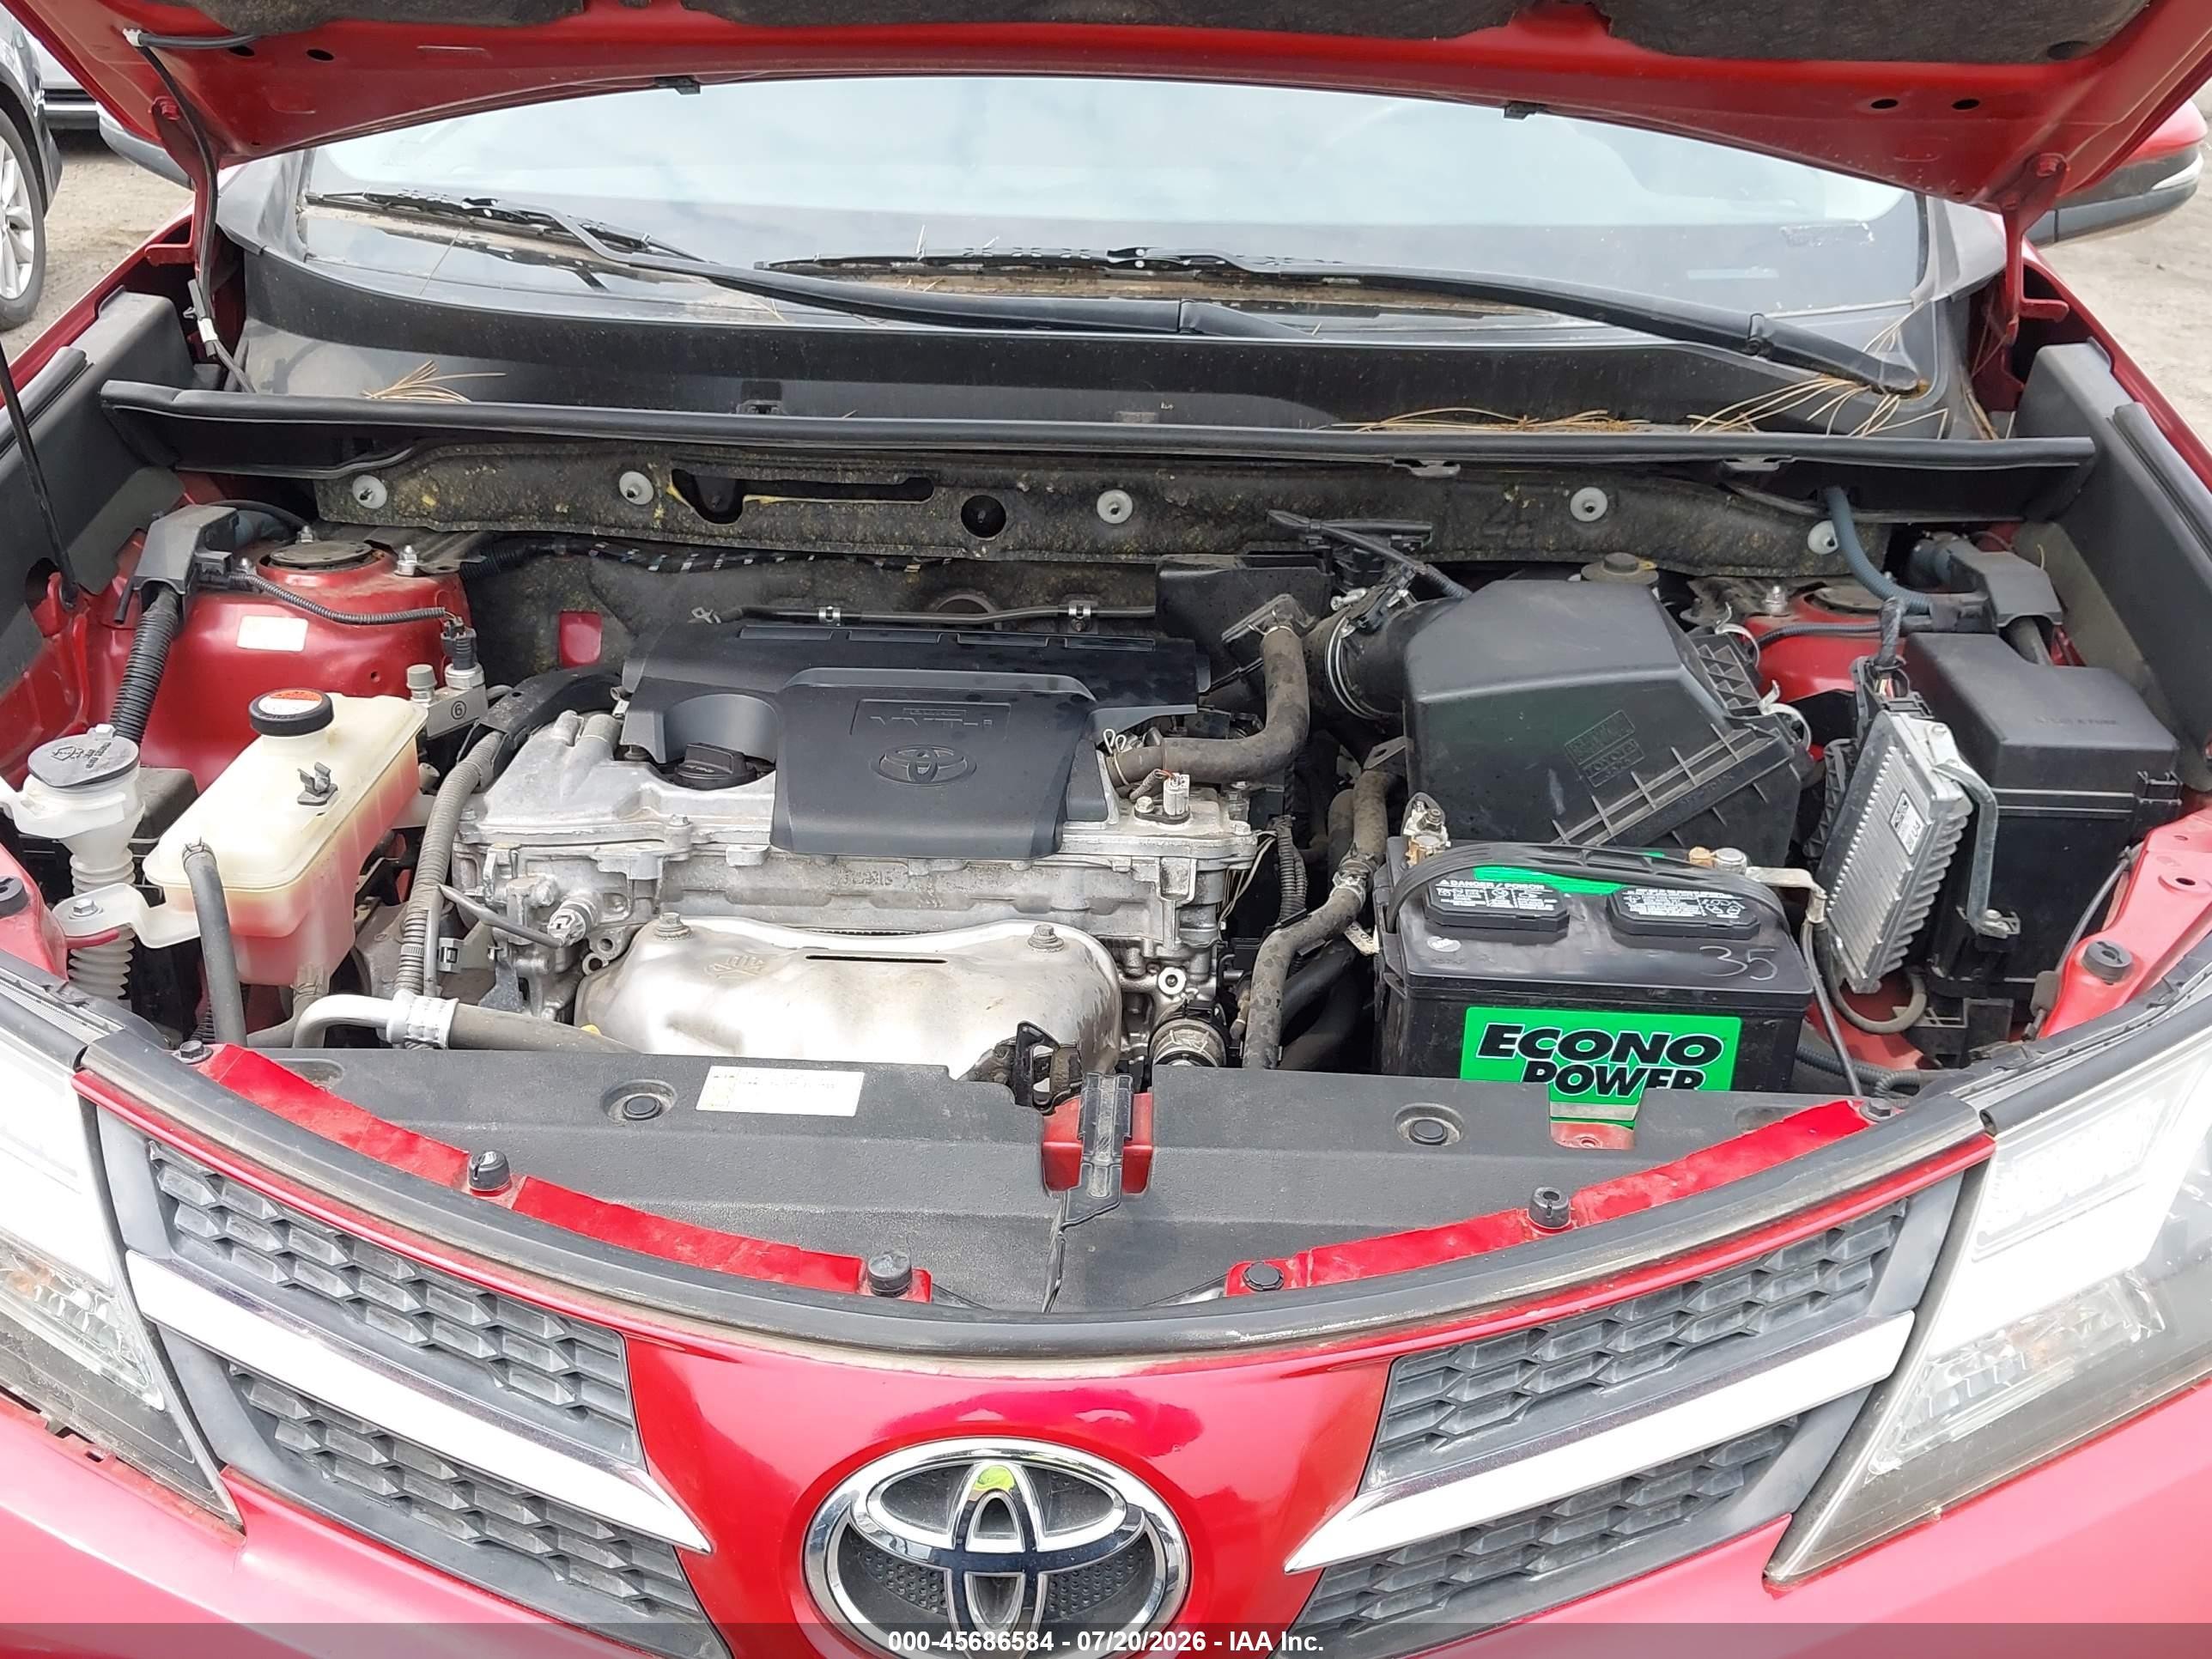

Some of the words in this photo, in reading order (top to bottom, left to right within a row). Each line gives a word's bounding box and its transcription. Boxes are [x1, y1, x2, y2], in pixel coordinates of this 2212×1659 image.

[1450, 880, 1495, 889] DANGER
[1699, 945, 1777, 981] 35
[1476, 1023, 1724, 1067] ECONO
[1521, 1060, 1706, 1097] POWER
